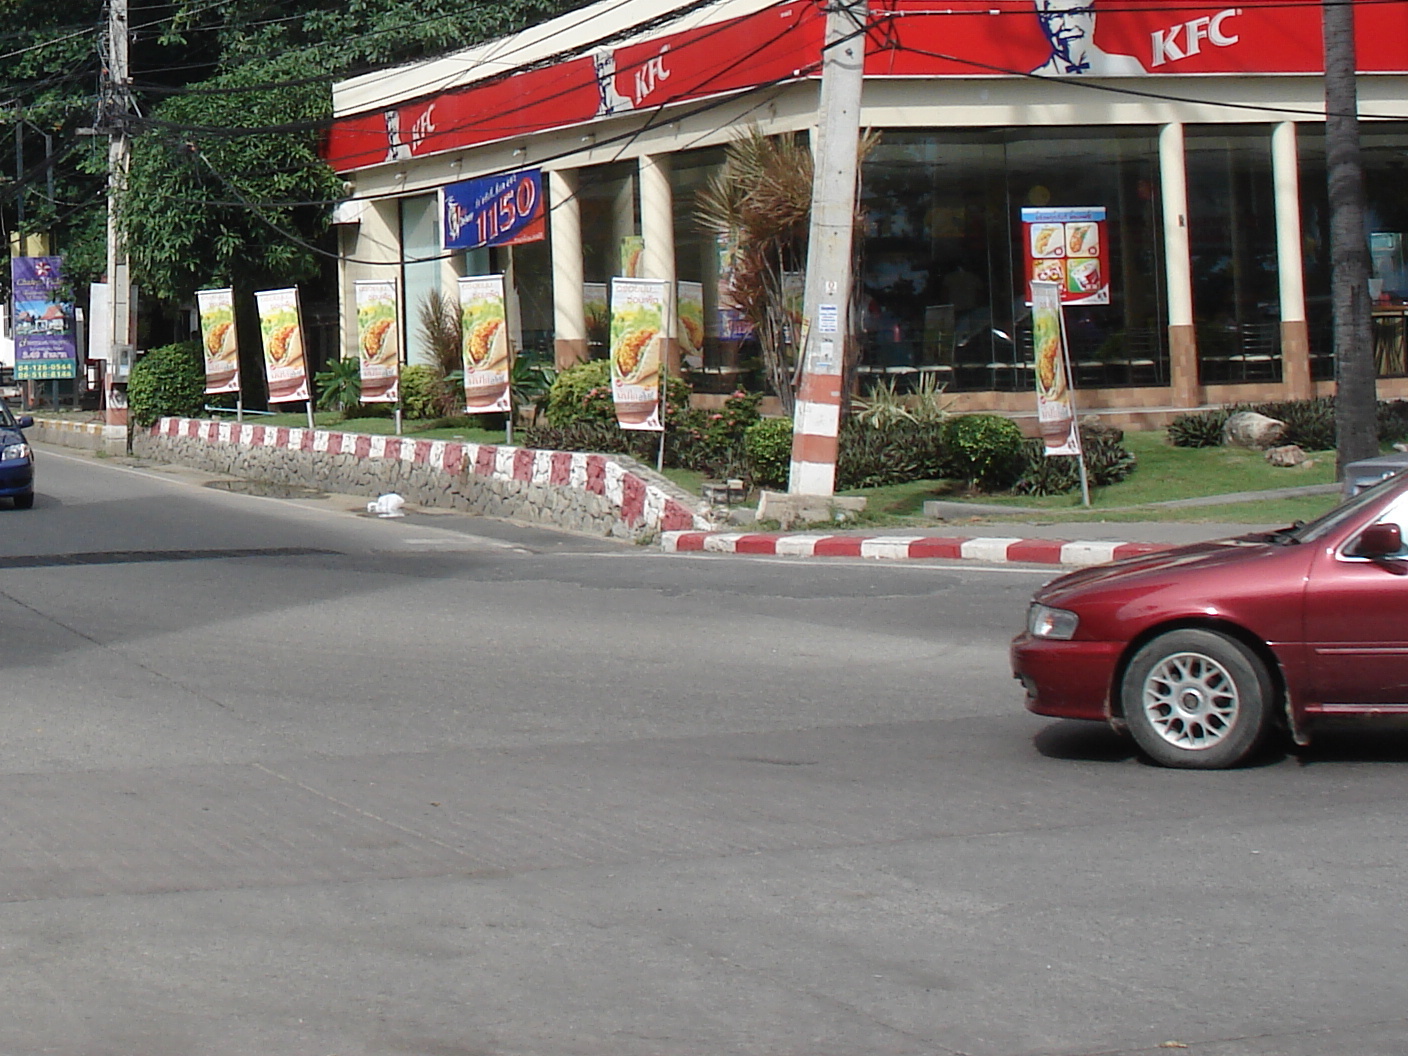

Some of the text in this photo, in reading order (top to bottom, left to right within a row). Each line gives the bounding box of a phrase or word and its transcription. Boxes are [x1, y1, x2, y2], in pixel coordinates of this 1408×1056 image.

[1151, 8, 1239, 67] KFC
[635, 44, 671, 106] KFC
[412, 103, 436, 152] KFC
[476, 177, 535, 247] 1150
